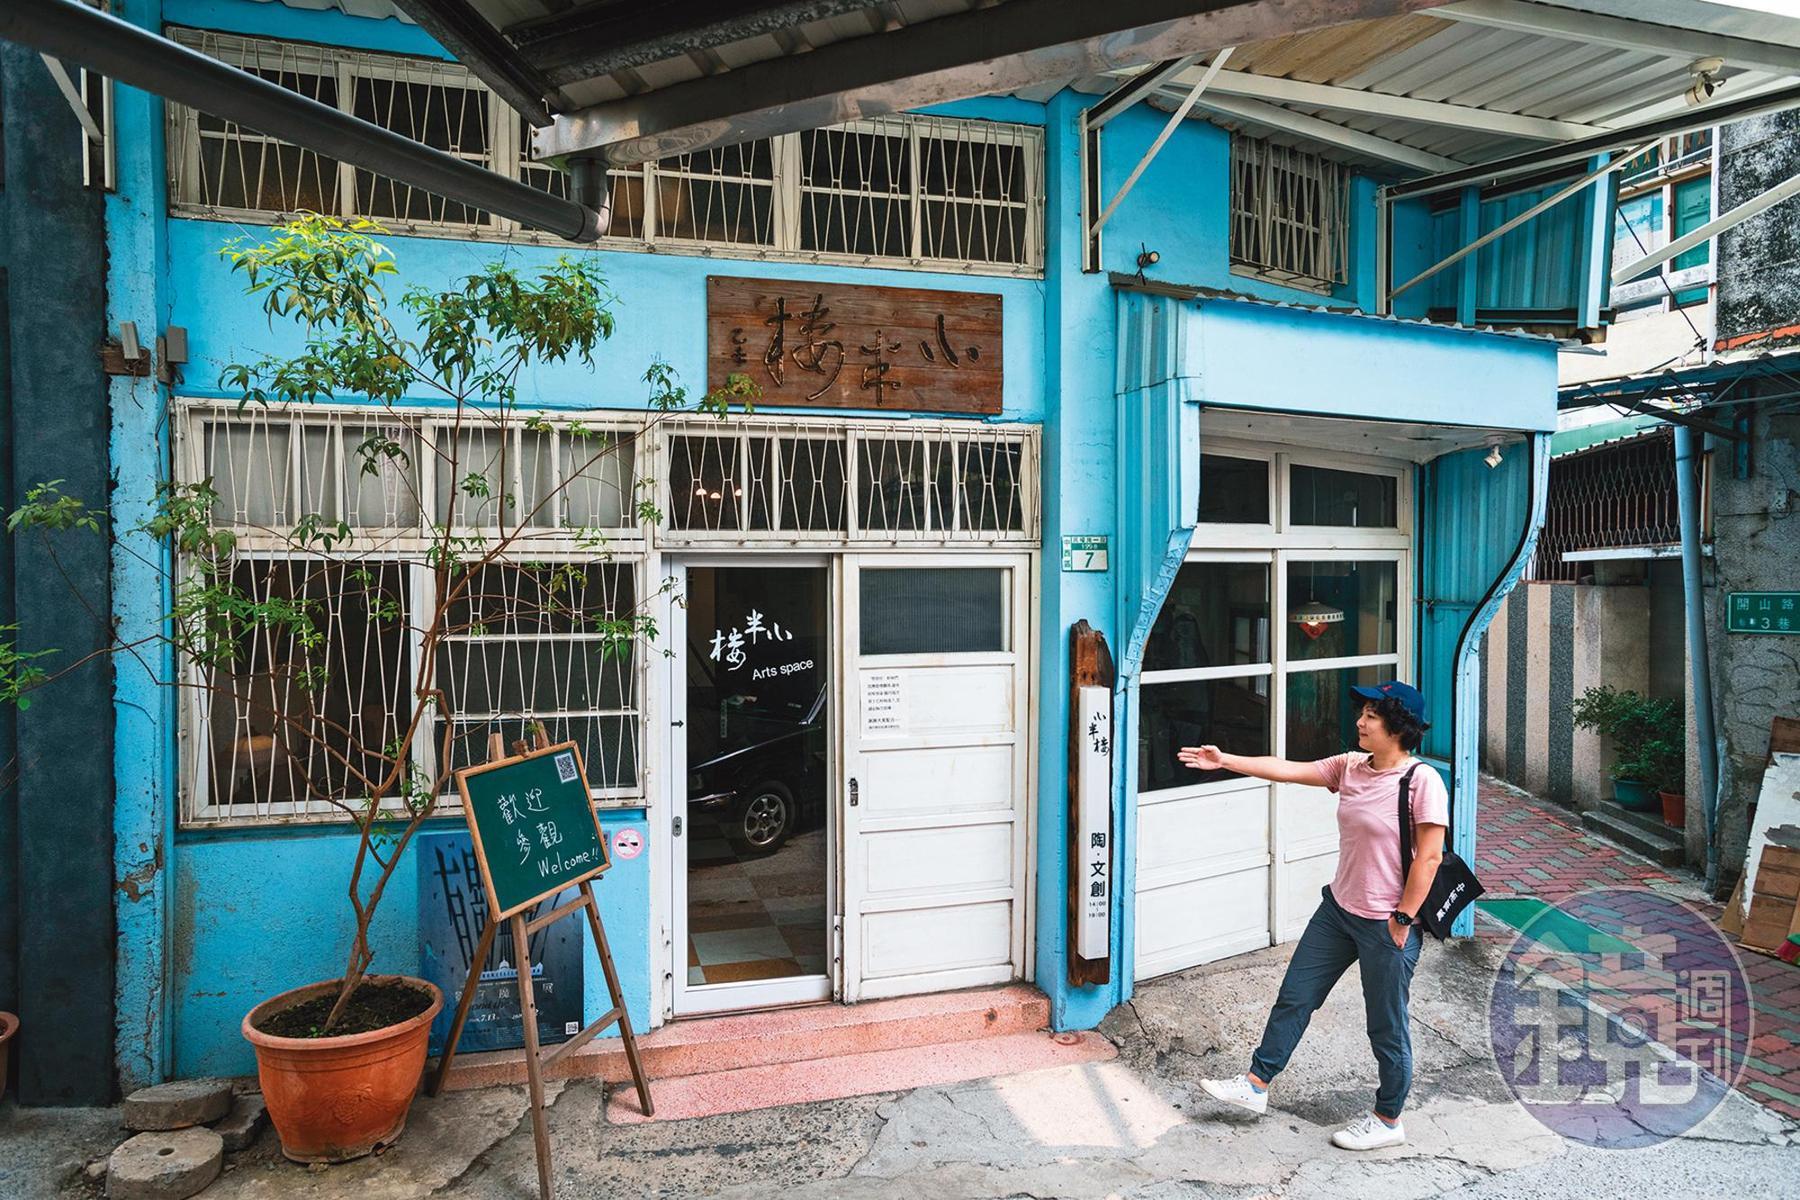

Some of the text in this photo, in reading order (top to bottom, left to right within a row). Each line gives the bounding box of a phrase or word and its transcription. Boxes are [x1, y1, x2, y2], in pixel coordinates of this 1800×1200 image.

[1085, 552, 1095, 569] 7
[752, 657, 814, 681] Arts space
